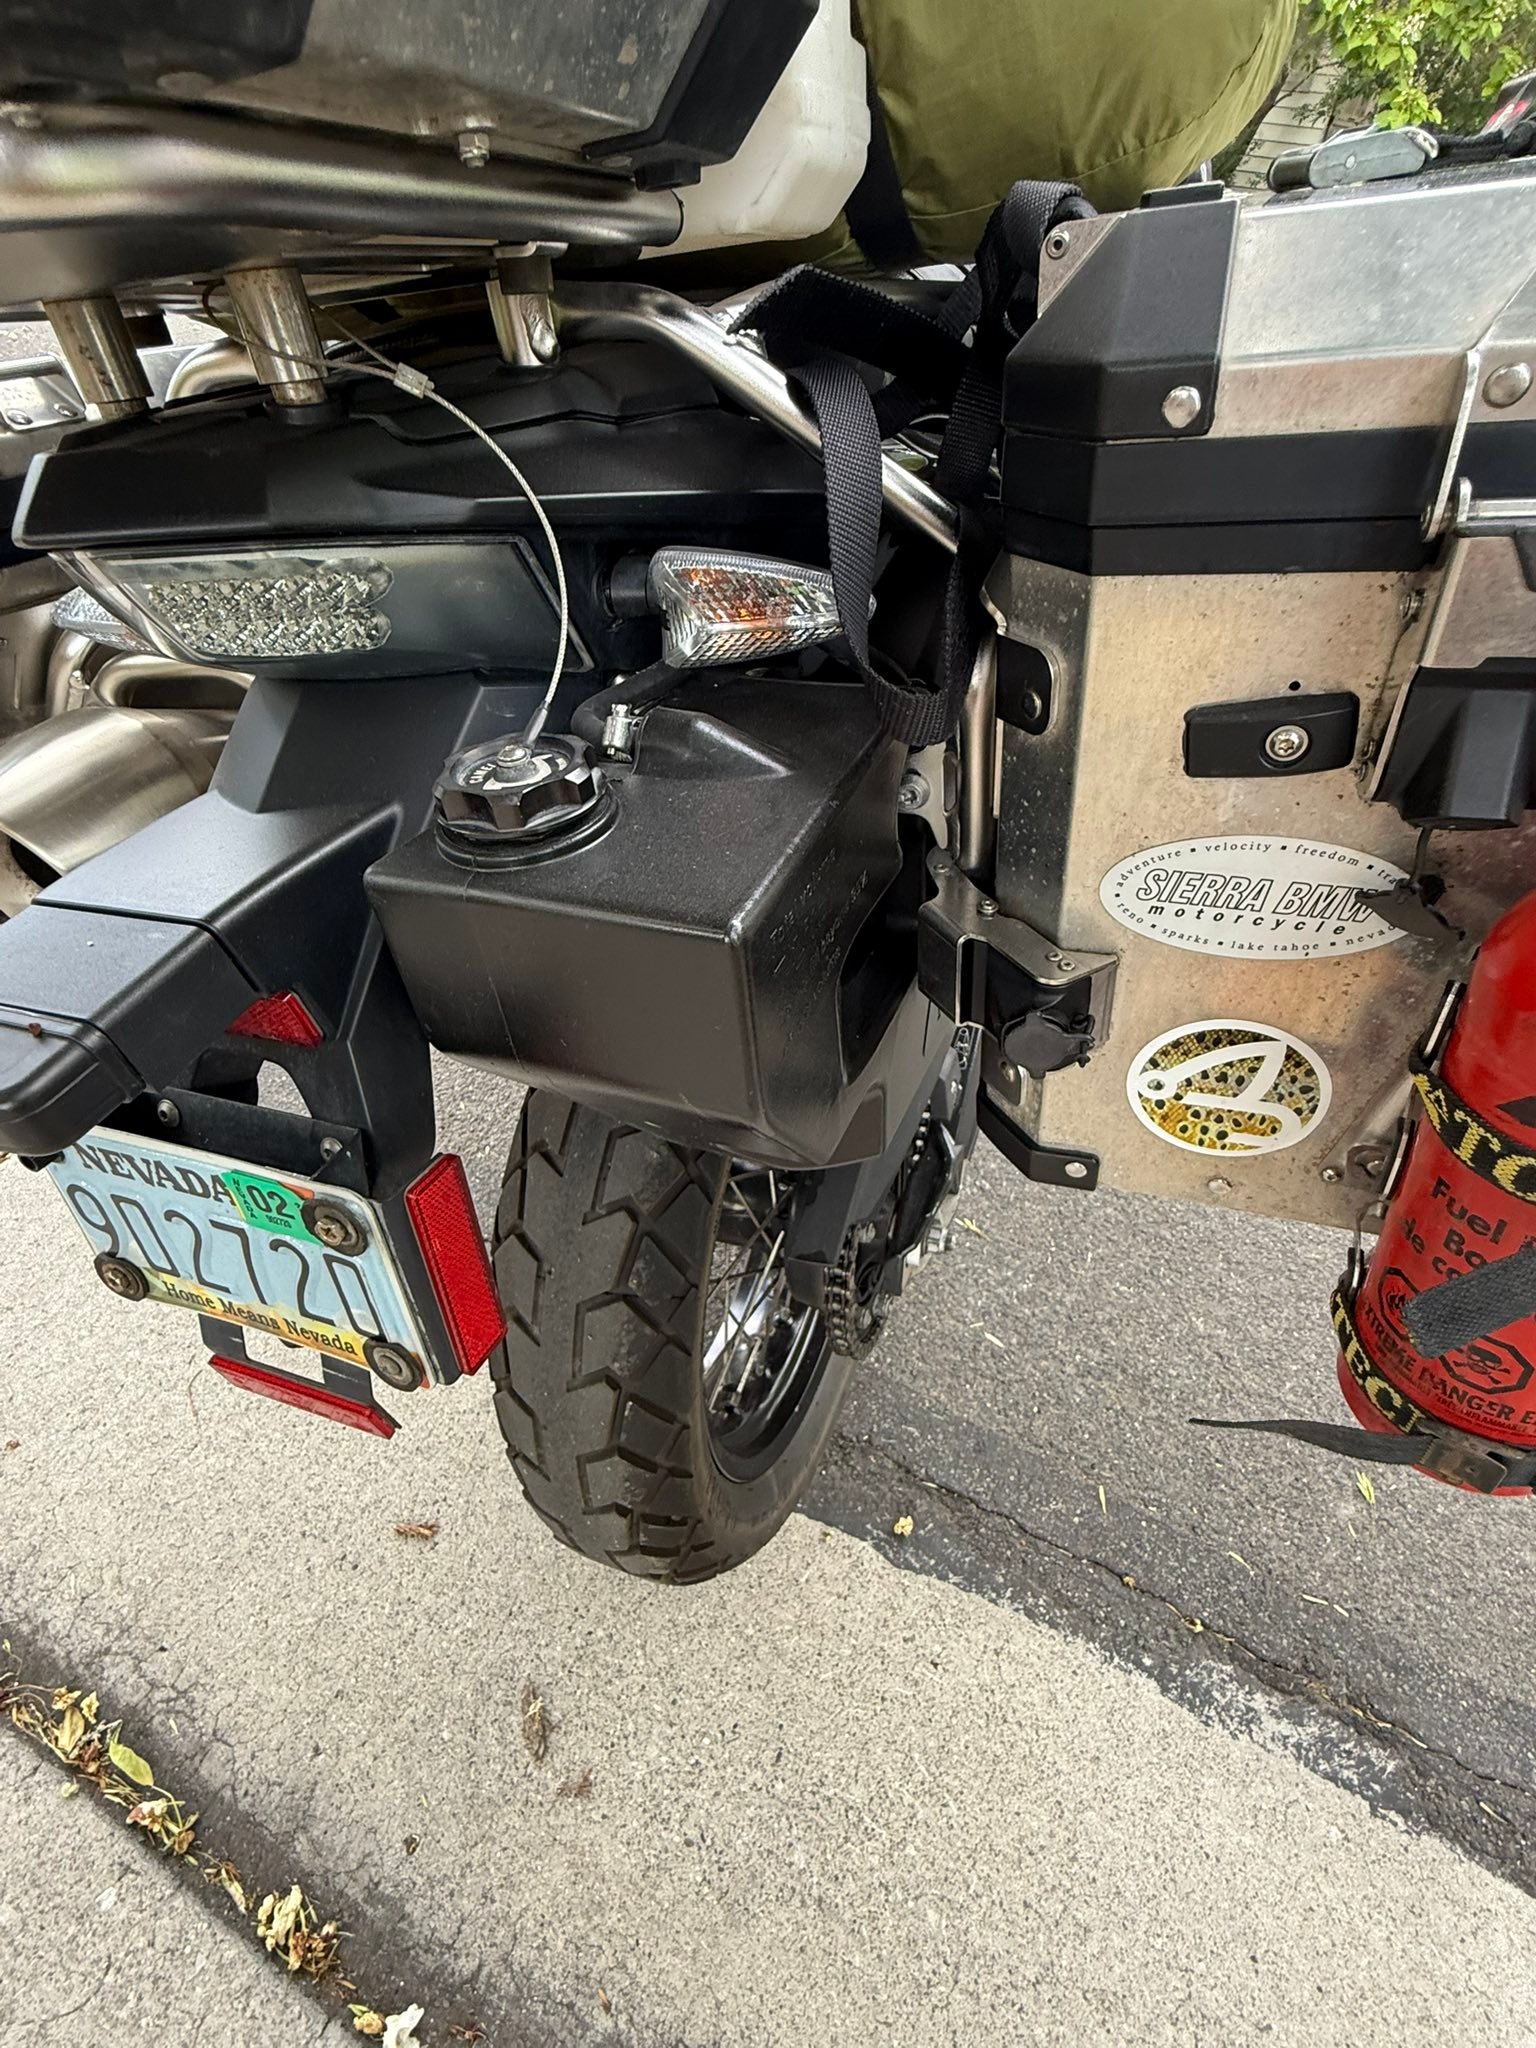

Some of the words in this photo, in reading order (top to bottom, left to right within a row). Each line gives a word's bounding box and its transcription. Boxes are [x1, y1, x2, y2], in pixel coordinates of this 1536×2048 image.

[1116, 851, 1182, 887] adventure
[1205, 841, 1271, 853] velocity
[1295, 844, 1360, 866] freedom
[1377, 869, 1397, 885] tra
[1136, 868, 1274, 912] SIERRA
[1272, 881, 1379, 923] BMW
[1148, 905, 1346, 935] motorcycle
[1117, 902, 1144, 924] reno
[1162, 928, 1209, 945] sparks
[1231, 941, 1265, 951] lake
[1274, 943, 1319, 952] tahoe
[74, 1143, 236, 1207] NEVADA
[246, 1185, 296, 1220] 02
[1431, 1176, 1508, 1245] Fuel
[66, 1183, 387, 1338] 902720
[1443, 1228, 1488, 1268] Bo
[162, 1280, 217, 1315] Home
[221, 1300, 282, 1336] Means
[287, 1319, 358, 1357] Nevada
